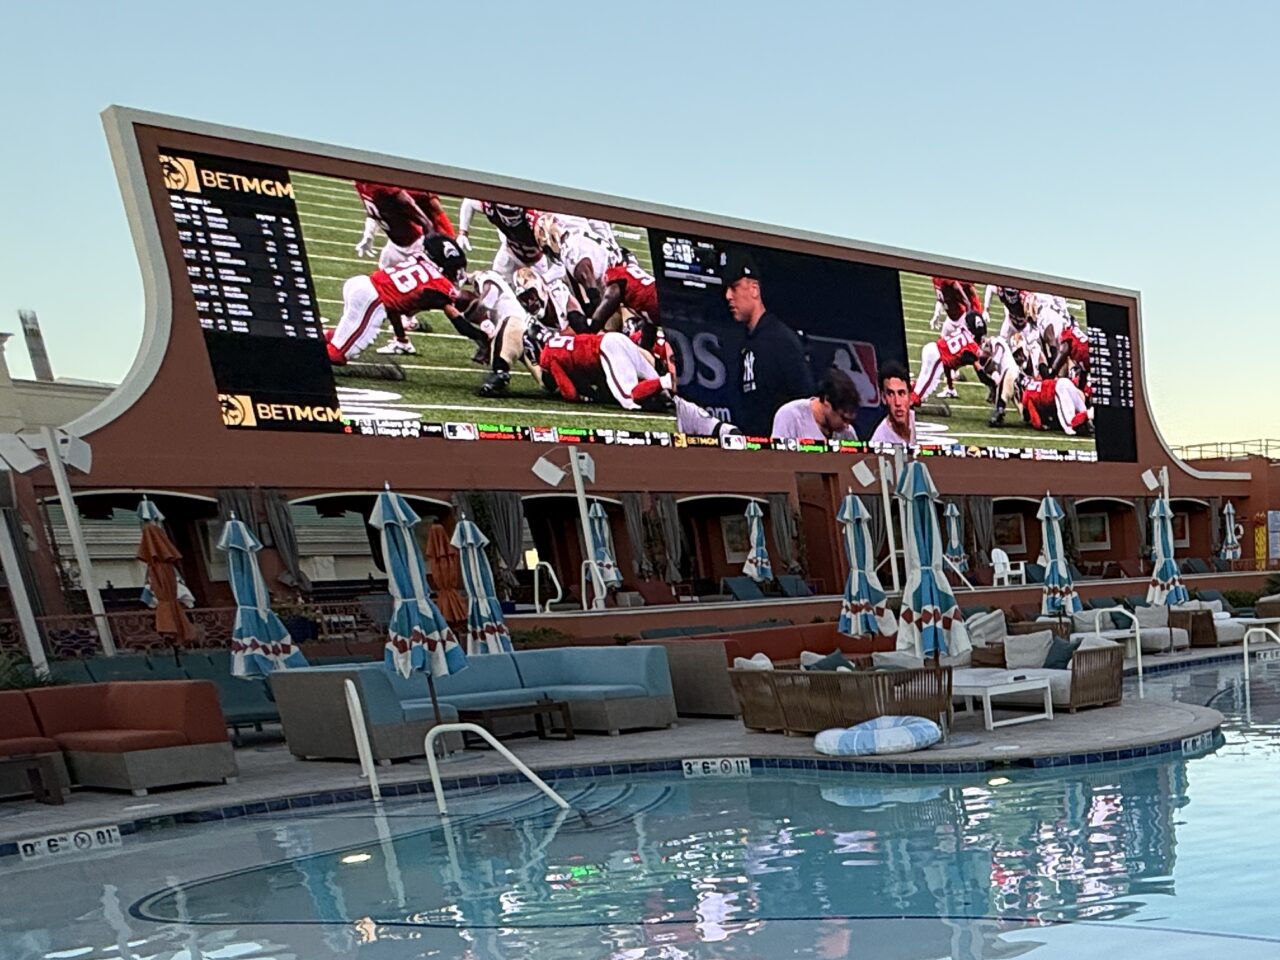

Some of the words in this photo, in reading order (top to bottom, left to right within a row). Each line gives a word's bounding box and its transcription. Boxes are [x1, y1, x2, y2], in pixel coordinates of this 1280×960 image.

[201, 169, 296, 200] BETMGM
[256, 403, 345, 423] BETMGM
[687, 436, 719, 446] BETMGM
[684, 761, 693, 775] 3
[702, 761, 711, 775] 6
[47, 838, 60, 853] 6
